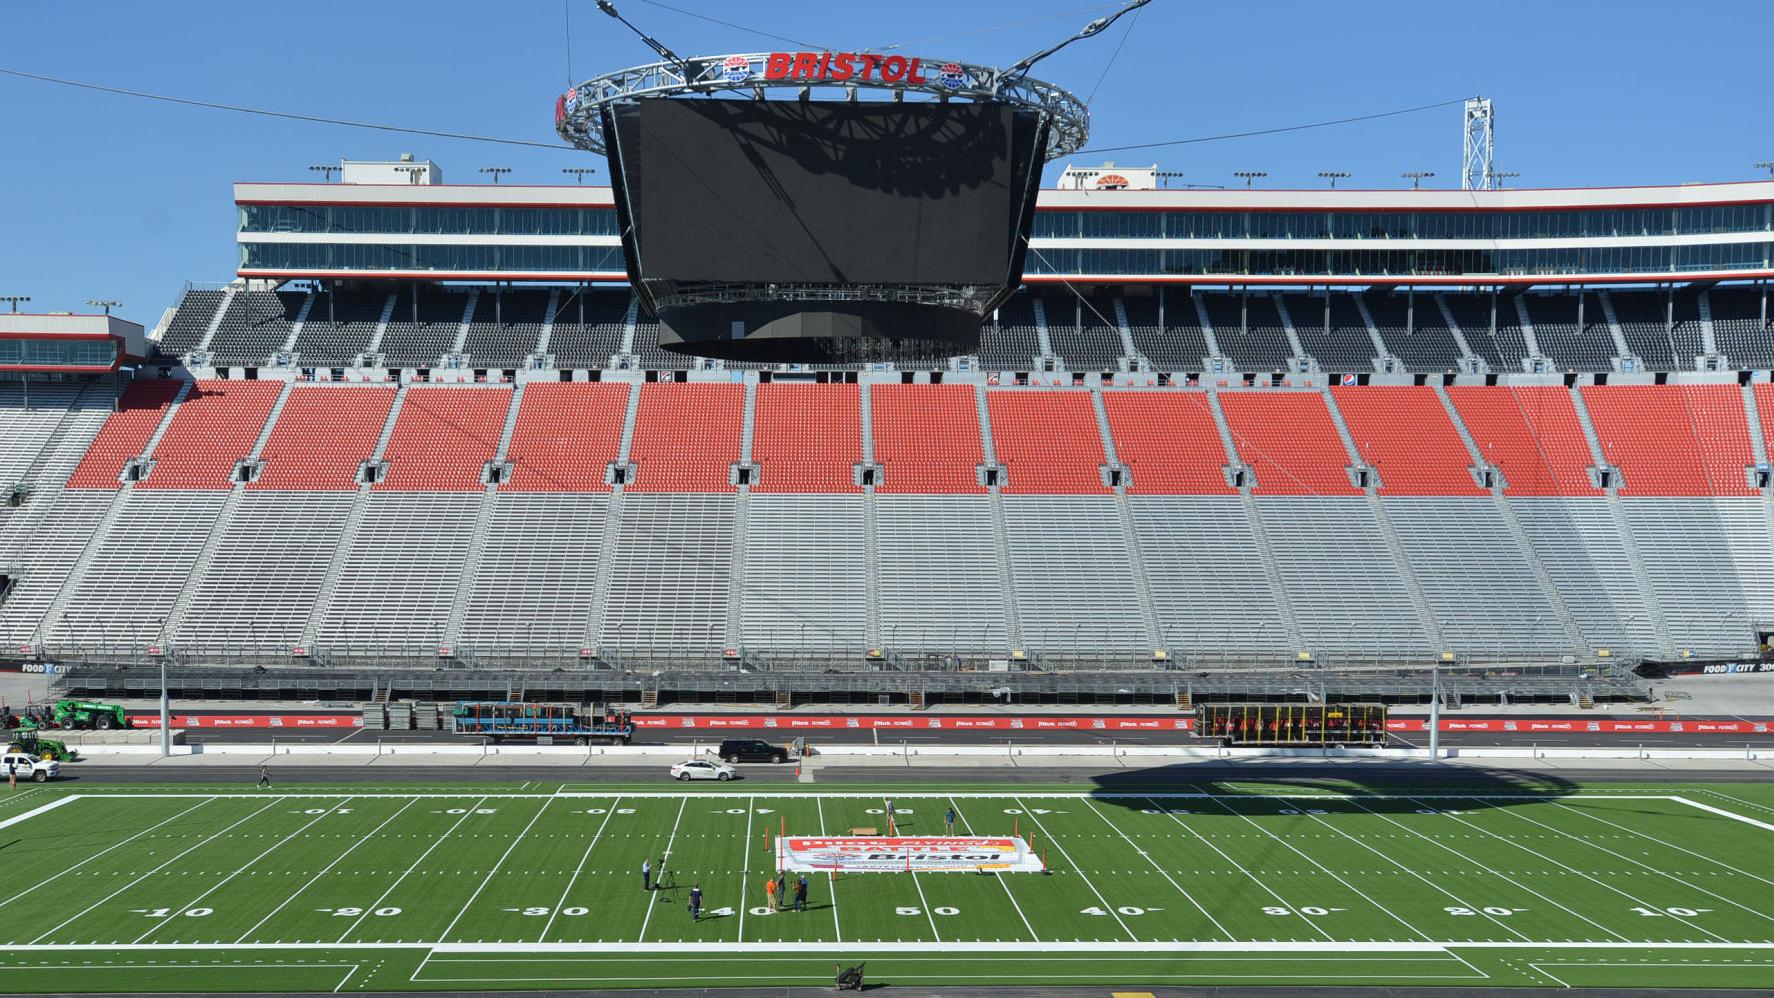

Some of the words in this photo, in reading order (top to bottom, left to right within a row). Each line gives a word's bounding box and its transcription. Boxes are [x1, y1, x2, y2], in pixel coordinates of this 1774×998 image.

[765, 53, 926, 84] BRISTOL
[22, 664, 44, 673] FOOD
[1703, 665, 1727, 673] FOOD
[1737, 664, 1755, 672] CITY
[895, 906, 961, 916] 50
